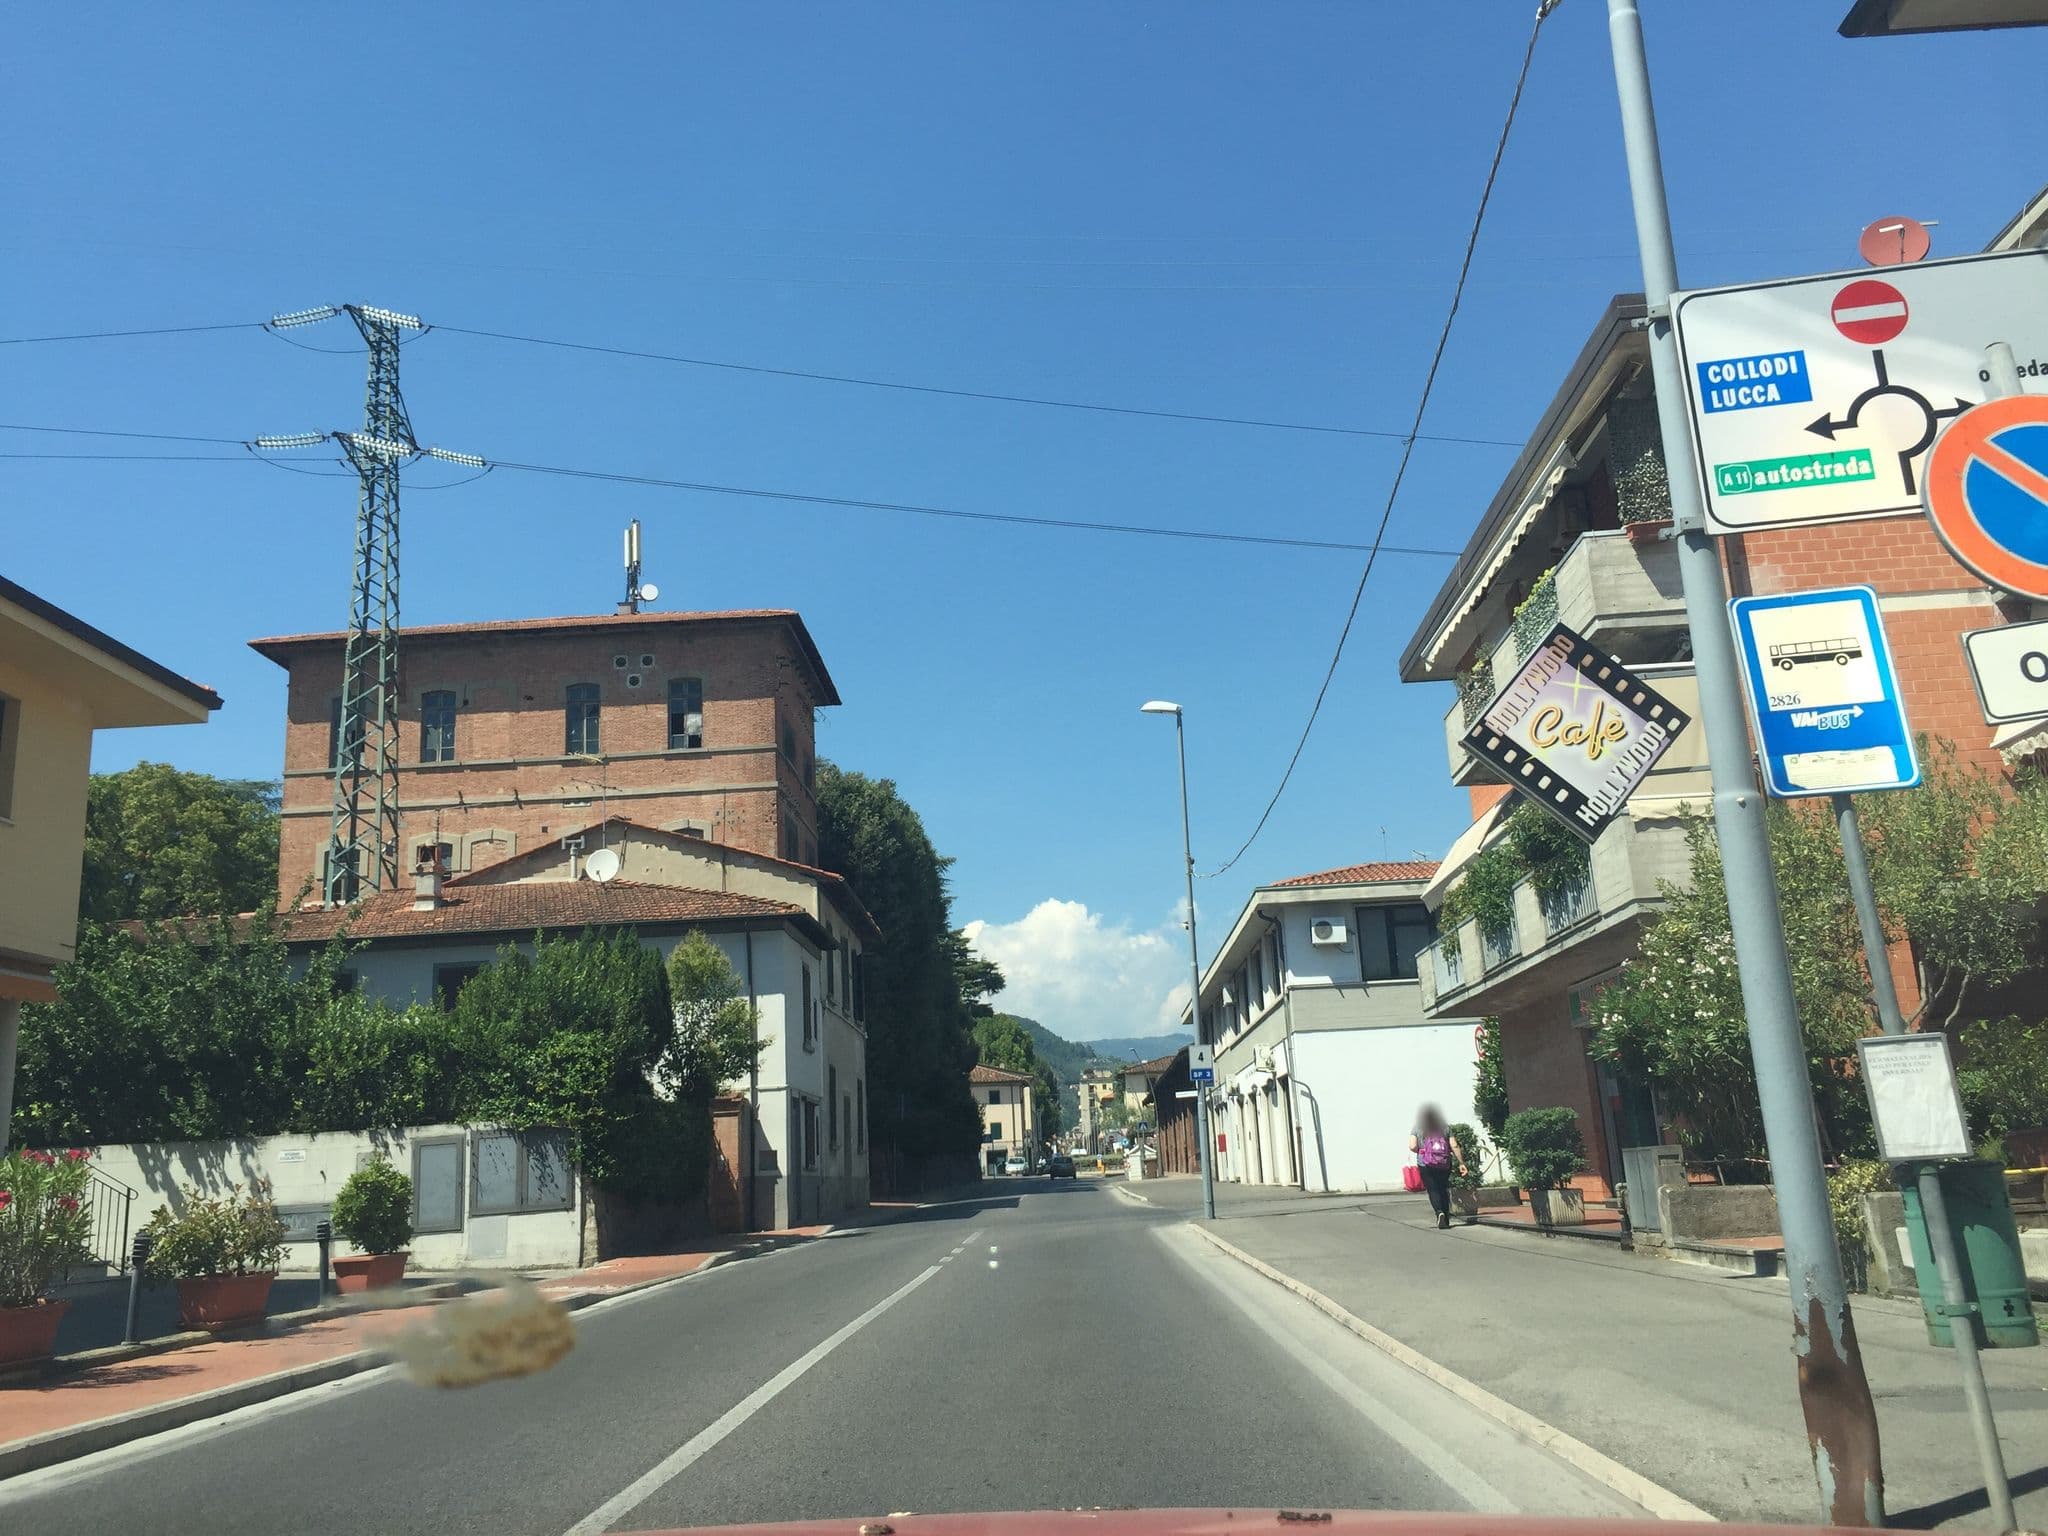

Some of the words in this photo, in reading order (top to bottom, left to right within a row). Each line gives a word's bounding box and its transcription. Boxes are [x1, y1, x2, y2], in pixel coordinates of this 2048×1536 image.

[1707, 356, 1798, 383] COLLODI
[1711, 383, 1781, 408] LUCCA
[1754, 456, 1872, 486] autostrada
[1485, 634, 1575, 736] HOLLYWOOD
[1770, 694, 1801, 707] 2826
[1576, 721, 1667, 827] HOLLYWOOD
